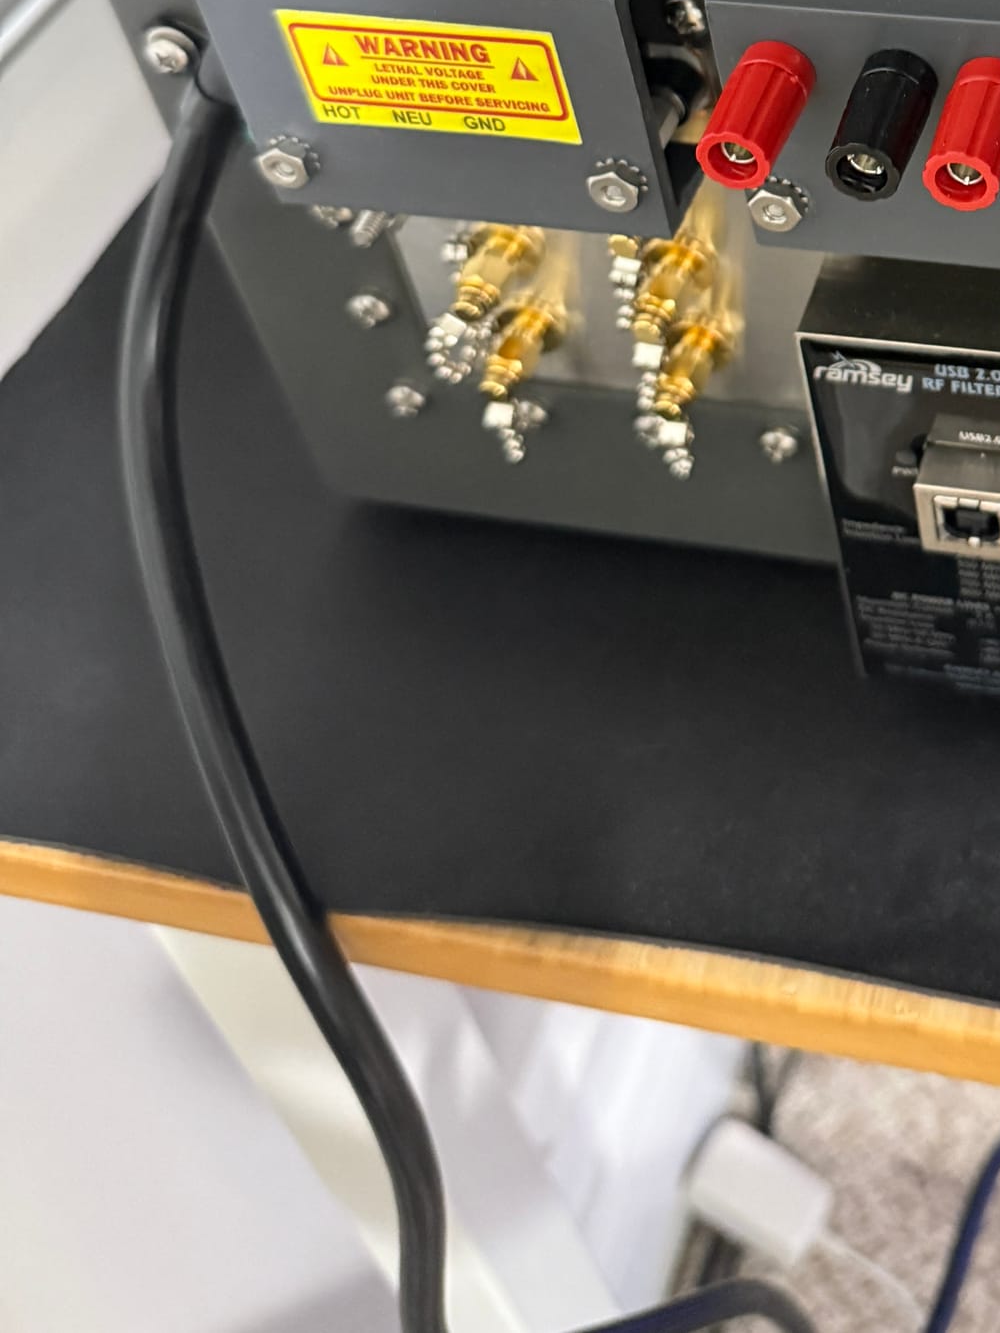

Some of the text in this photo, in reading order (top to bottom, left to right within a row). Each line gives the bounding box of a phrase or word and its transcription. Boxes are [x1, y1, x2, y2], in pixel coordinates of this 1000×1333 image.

[354, 35, 491, 64] WARNING
[373, 63, 485, 80] LETHAL VOLTAGE
[371, 75, 496, 94] UNDER THIS COVER
[328, 86, 551, 112] UNPLUG UNIT BEFORE SERVICING
[321, 104, 506, 132] HOT NEU GND
[813, 365, 914, 394] ramsey
[933, 363, 970, 379] USB
[921, 377, 945, 391] RF
